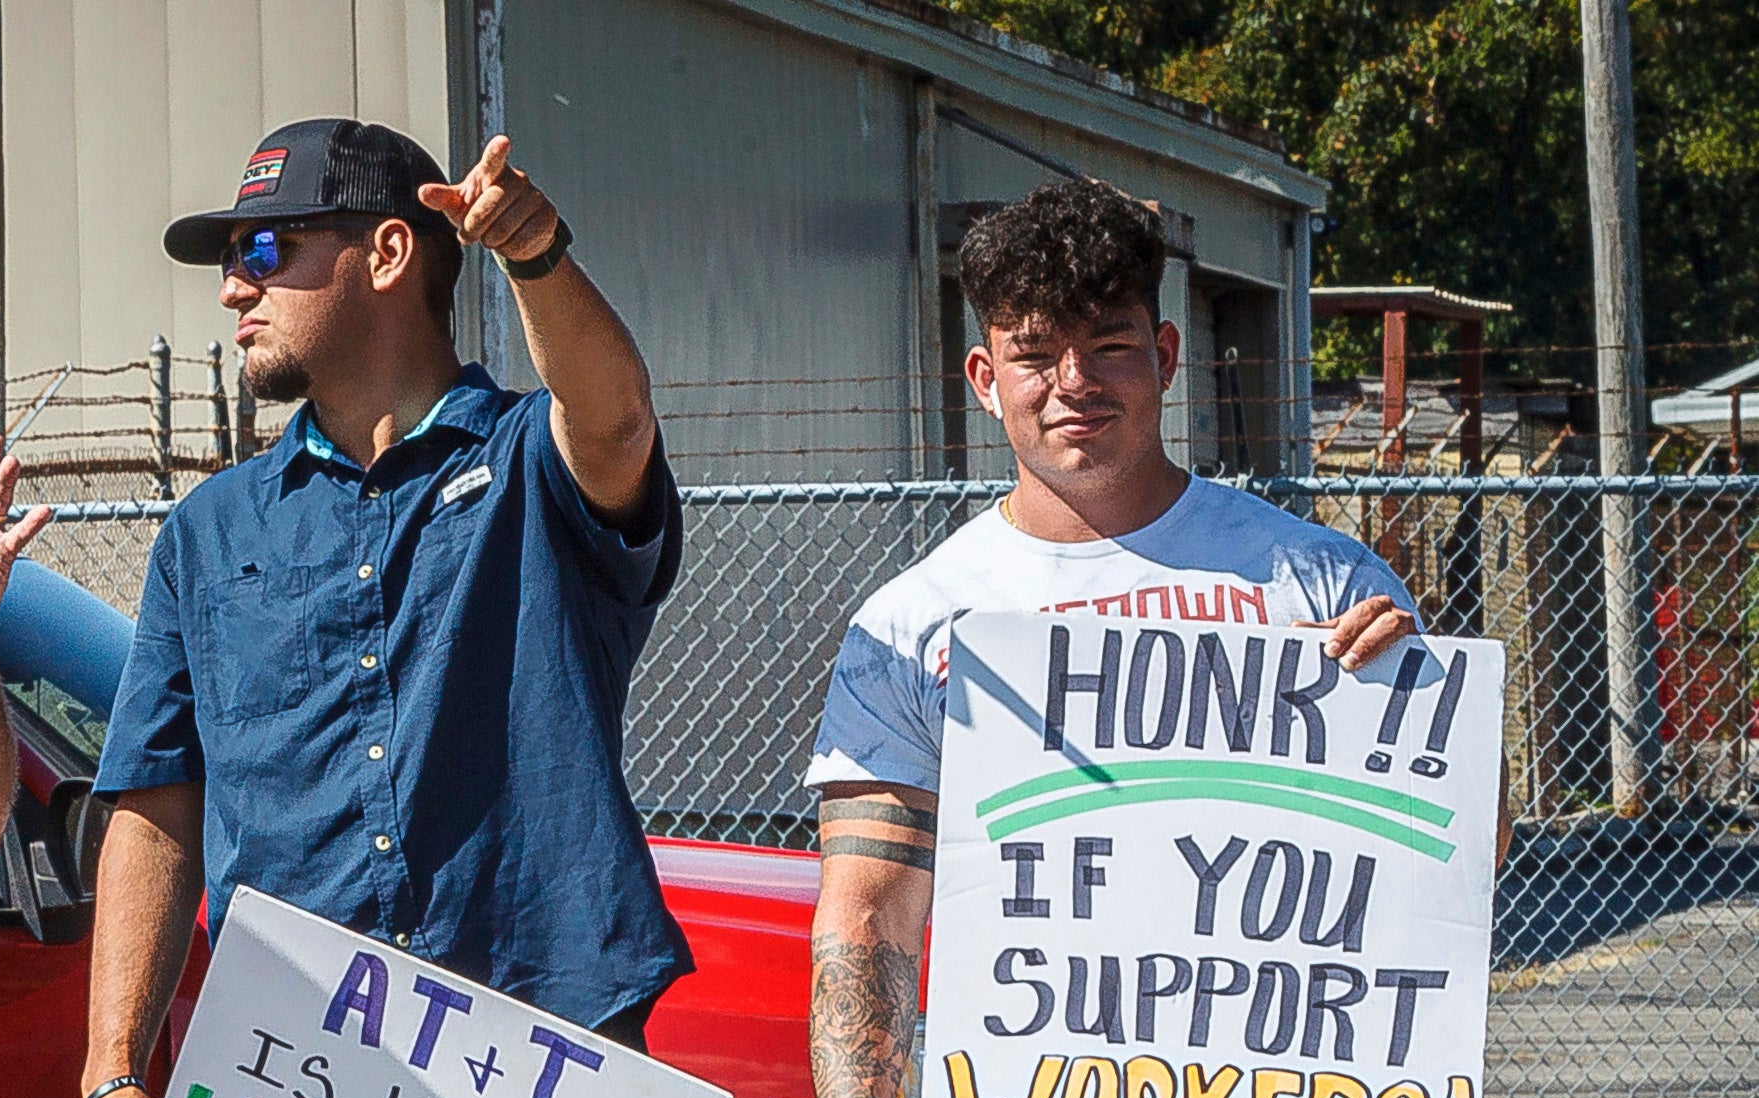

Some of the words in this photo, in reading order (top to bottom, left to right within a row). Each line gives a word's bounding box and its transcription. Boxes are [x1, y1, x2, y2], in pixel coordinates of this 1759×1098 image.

[1000, 836, 1114, 919] IF
[1174, 834, 1377, 953] YOU
[983, 947, 1449, 1067] SUPPORT
